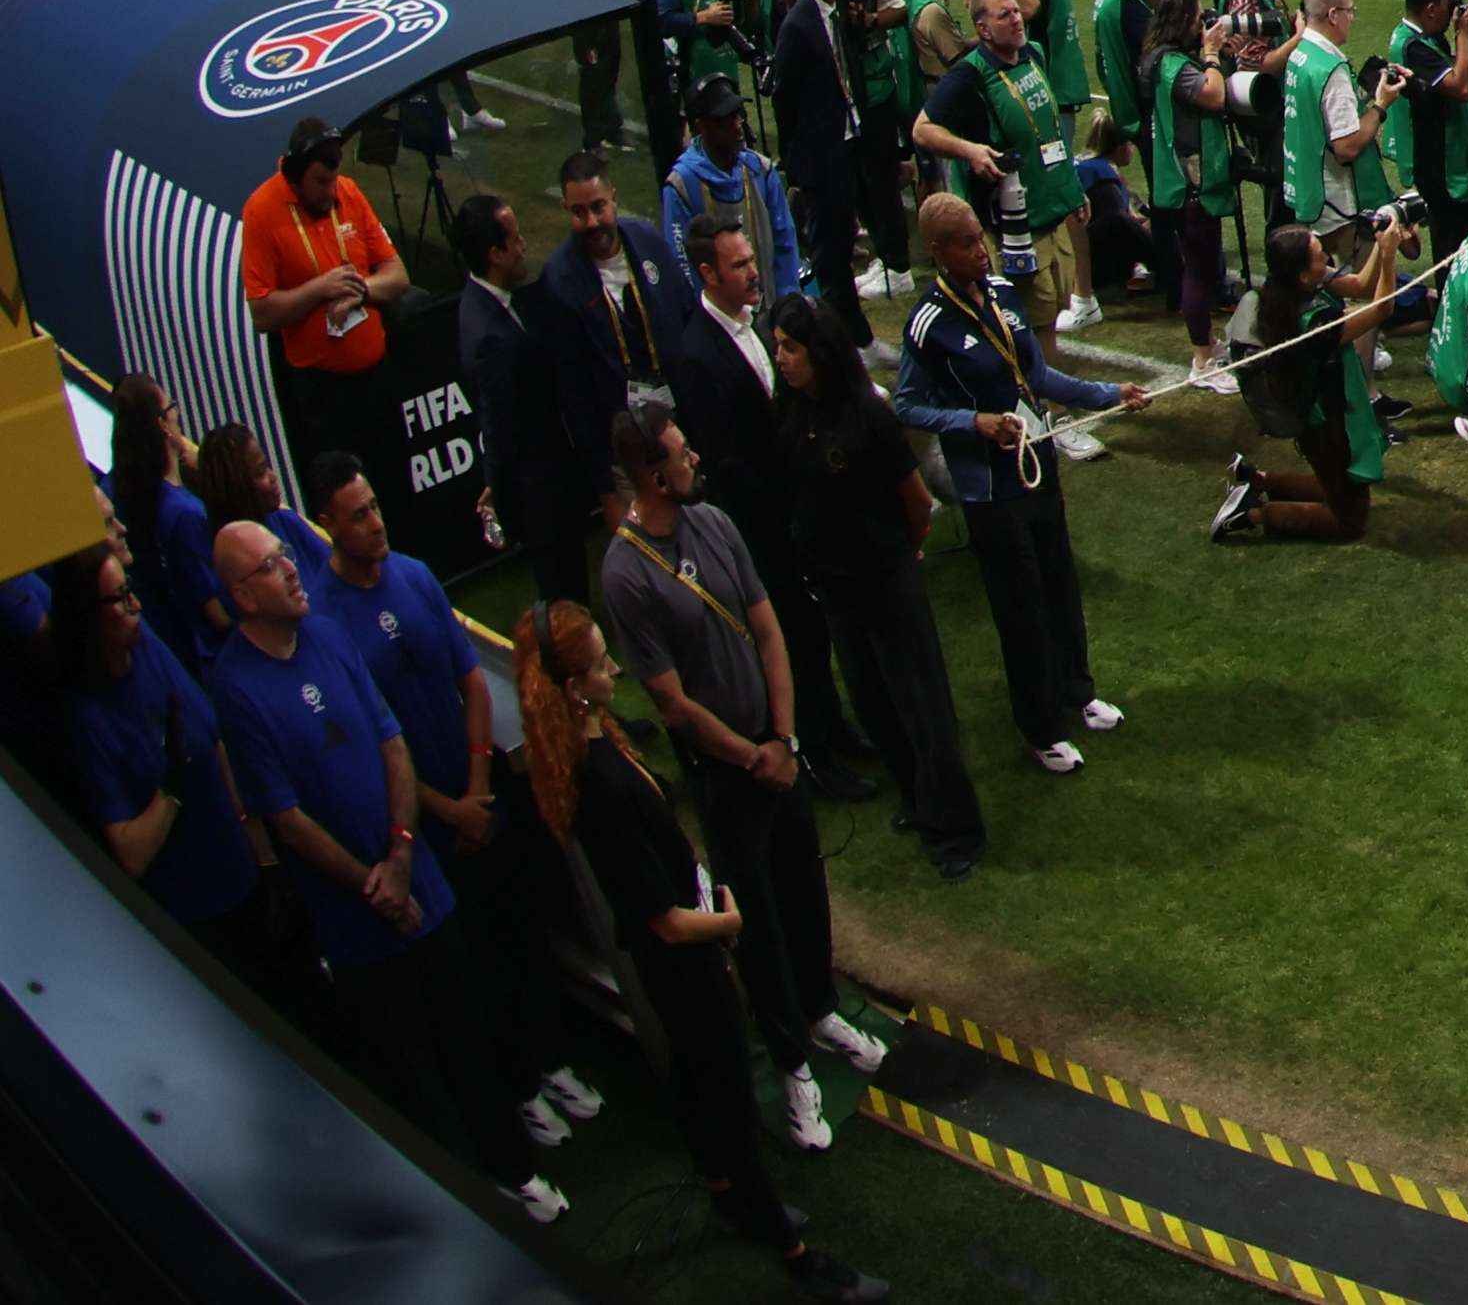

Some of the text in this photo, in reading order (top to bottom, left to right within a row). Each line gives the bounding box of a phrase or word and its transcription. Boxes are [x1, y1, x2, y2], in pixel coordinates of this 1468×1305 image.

[1026, 90, 1051, 112] 629
[401, 381, 473, 440] FIFA
[409, 437, 476, 494] RLD
